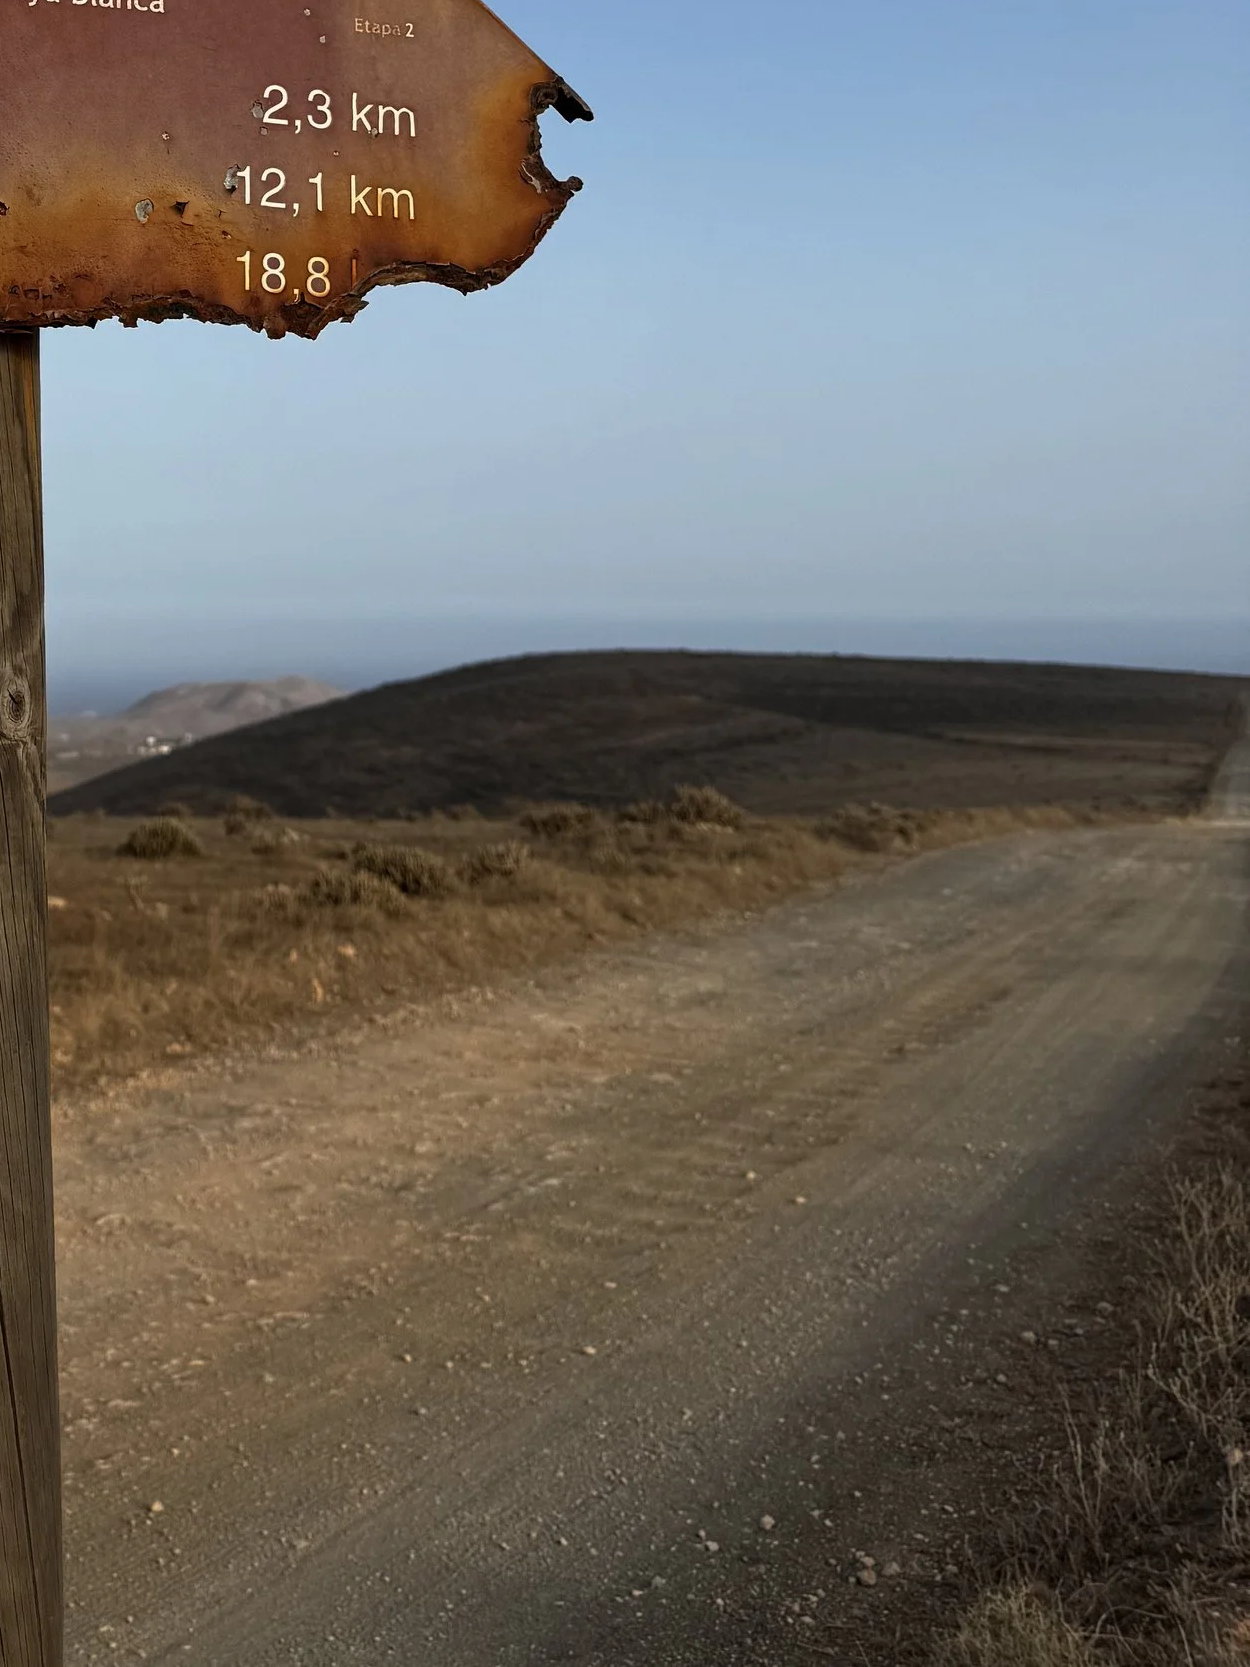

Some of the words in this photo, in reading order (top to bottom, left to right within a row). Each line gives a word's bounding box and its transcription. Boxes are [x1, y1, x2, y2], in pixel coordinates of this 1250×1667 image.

[354, 17, 401, 38] Etapa
[405, 22, 415, 38] 2
[262, 84, 333, 134] 2,3
[351, 92, 416, 137] km
[236, 165, 324, 218] 12,1
[350, 174, 416, 220] km
[236, 249, 331, 303] 18,8
